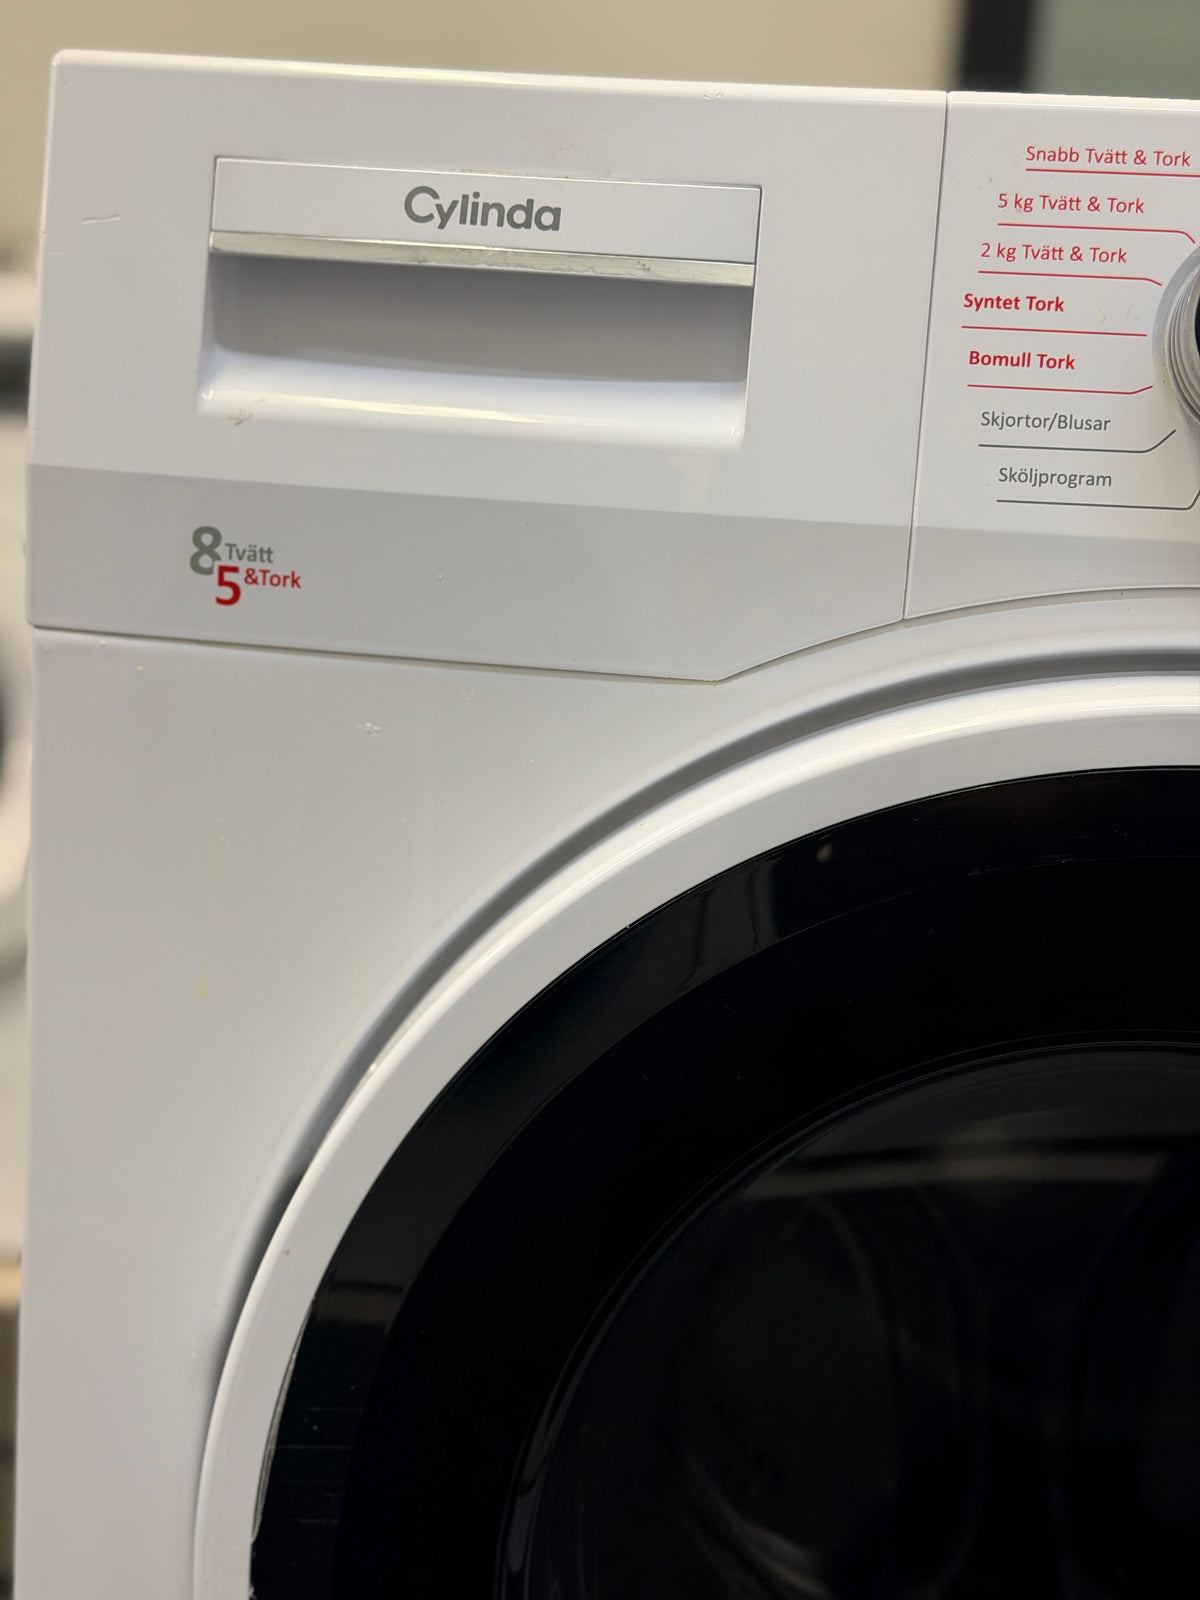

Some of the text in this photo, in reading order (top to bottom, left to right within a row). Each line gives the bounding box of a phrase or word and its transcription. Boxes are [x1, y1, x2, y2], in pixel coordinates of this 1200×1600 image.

[1026, 146, 1191, 167] Snabb Tvätt & Tork
[404, 186, 562, 232] Cylinda
[998, 193, 1145, 214] 5 kg Tvätt & Tork
[981, 243, 1127, 264] 2 kg Tvätt & Tork
[964, 293, 1065, 313] Syntet Tork
[969, 351, 1076, 370] Bomull Tork
[981, 411, 1112, 432] Skjortor/Blusar
[999, 467, 1112, 489] Sköljprogram
[190, 526, 273, 575] 8 Tvätt
[215, 565, 300, 606] 5 &Tork
